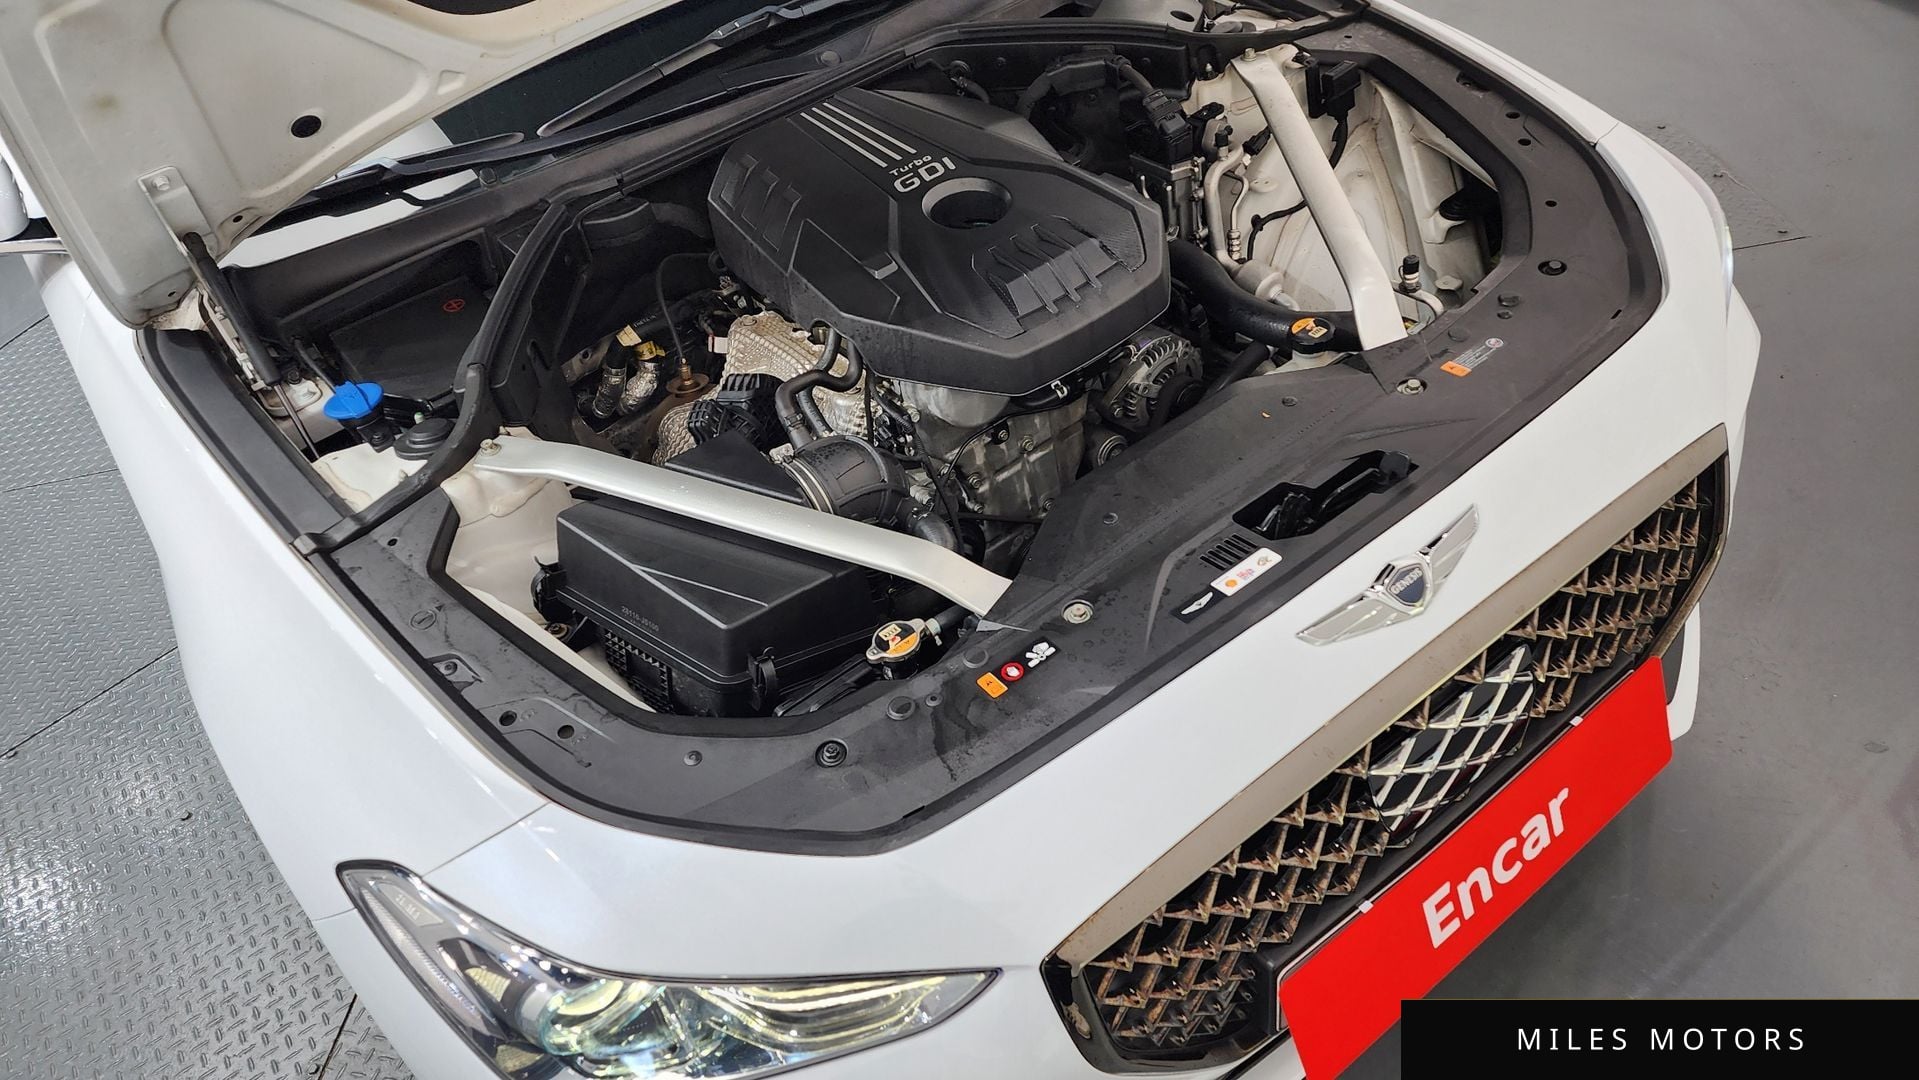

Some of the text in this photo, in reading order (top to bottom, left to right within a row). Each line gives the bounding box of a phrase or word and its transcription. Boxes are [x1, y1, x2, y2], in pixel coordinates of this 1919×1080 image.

[888, 155, 932, 176] Turbo
[894, 156, 956, 193] GDI
[1390, 567, 1423, 595] GENESIS
[1422, 787, 1569, 949] Encar
